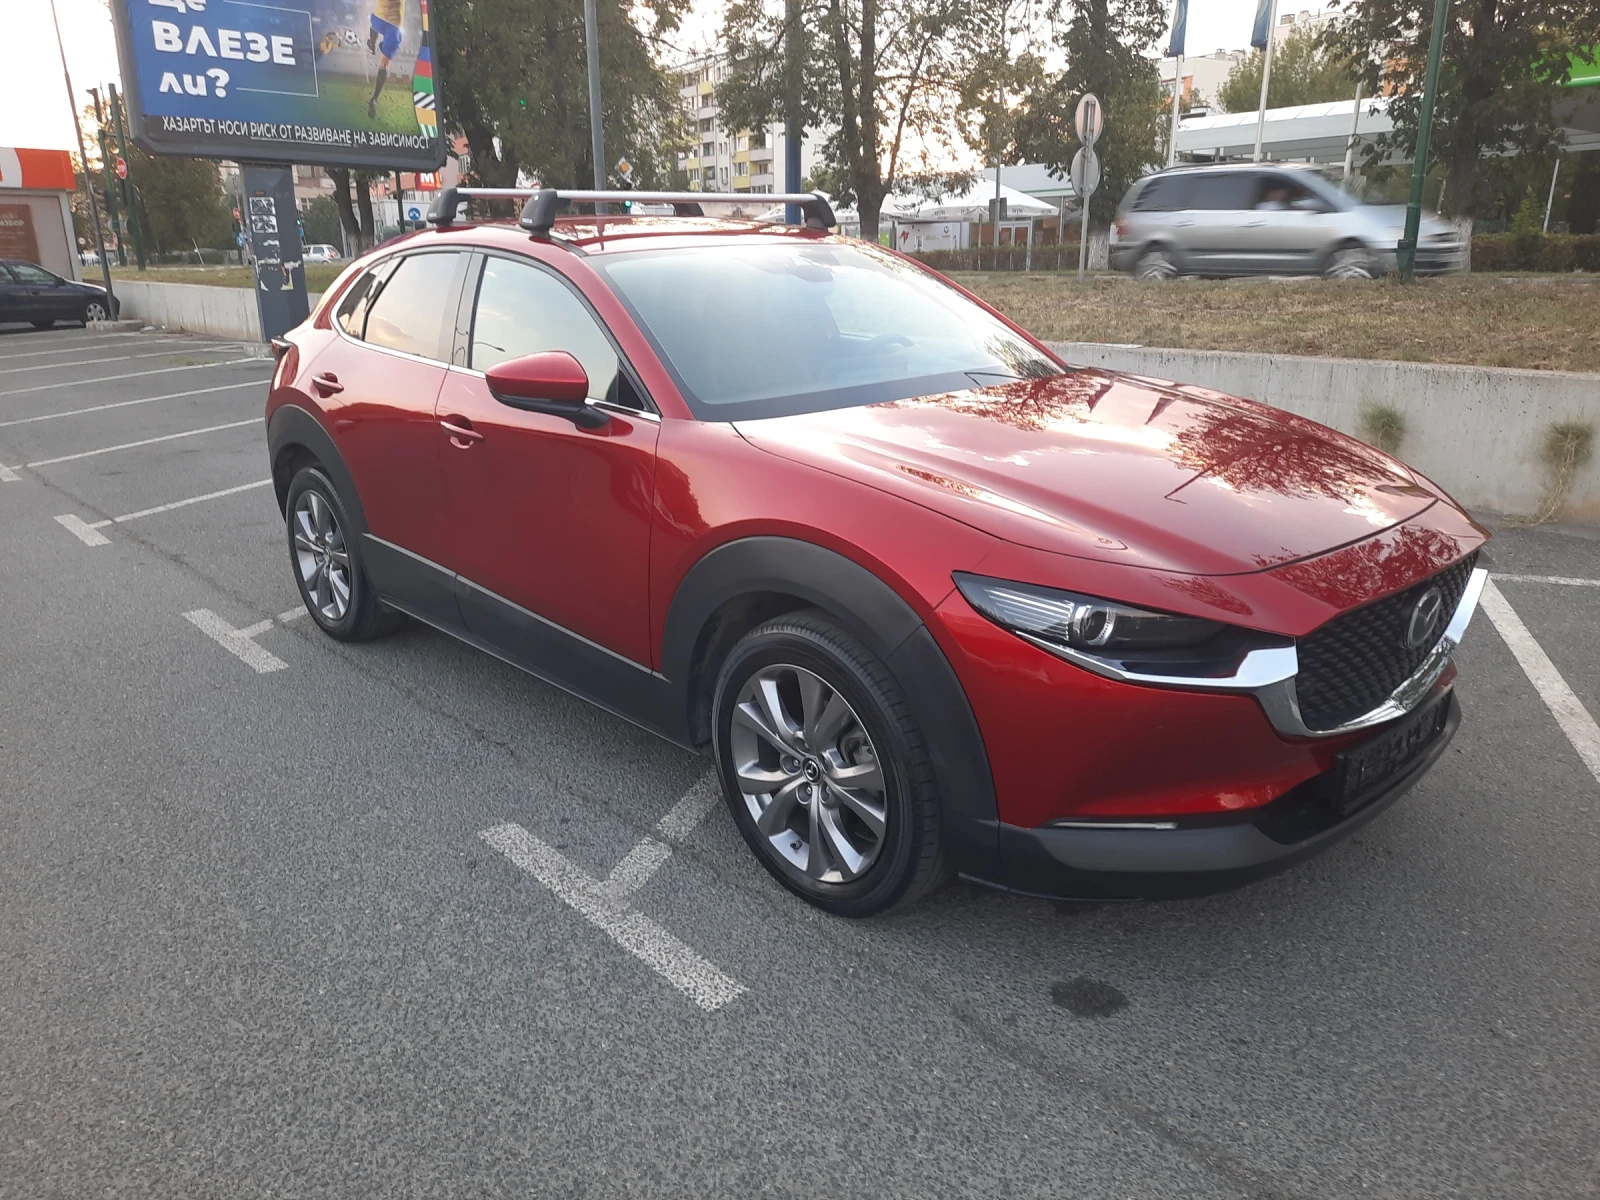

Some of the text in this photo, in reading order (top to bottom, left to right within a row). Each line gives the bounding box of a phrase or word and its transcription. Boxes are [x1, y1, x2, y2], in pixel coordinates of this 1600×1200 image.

[151, 20, 297, 66] ВЛЕЗЕ
[159, 68, 231, 98] ли?
[161, 115, 430, 149] ХАЗАРТЪТ НОСИ РИСК ОТ РАЗВИВАНЕ НА ЗАВИСИМОСТ
